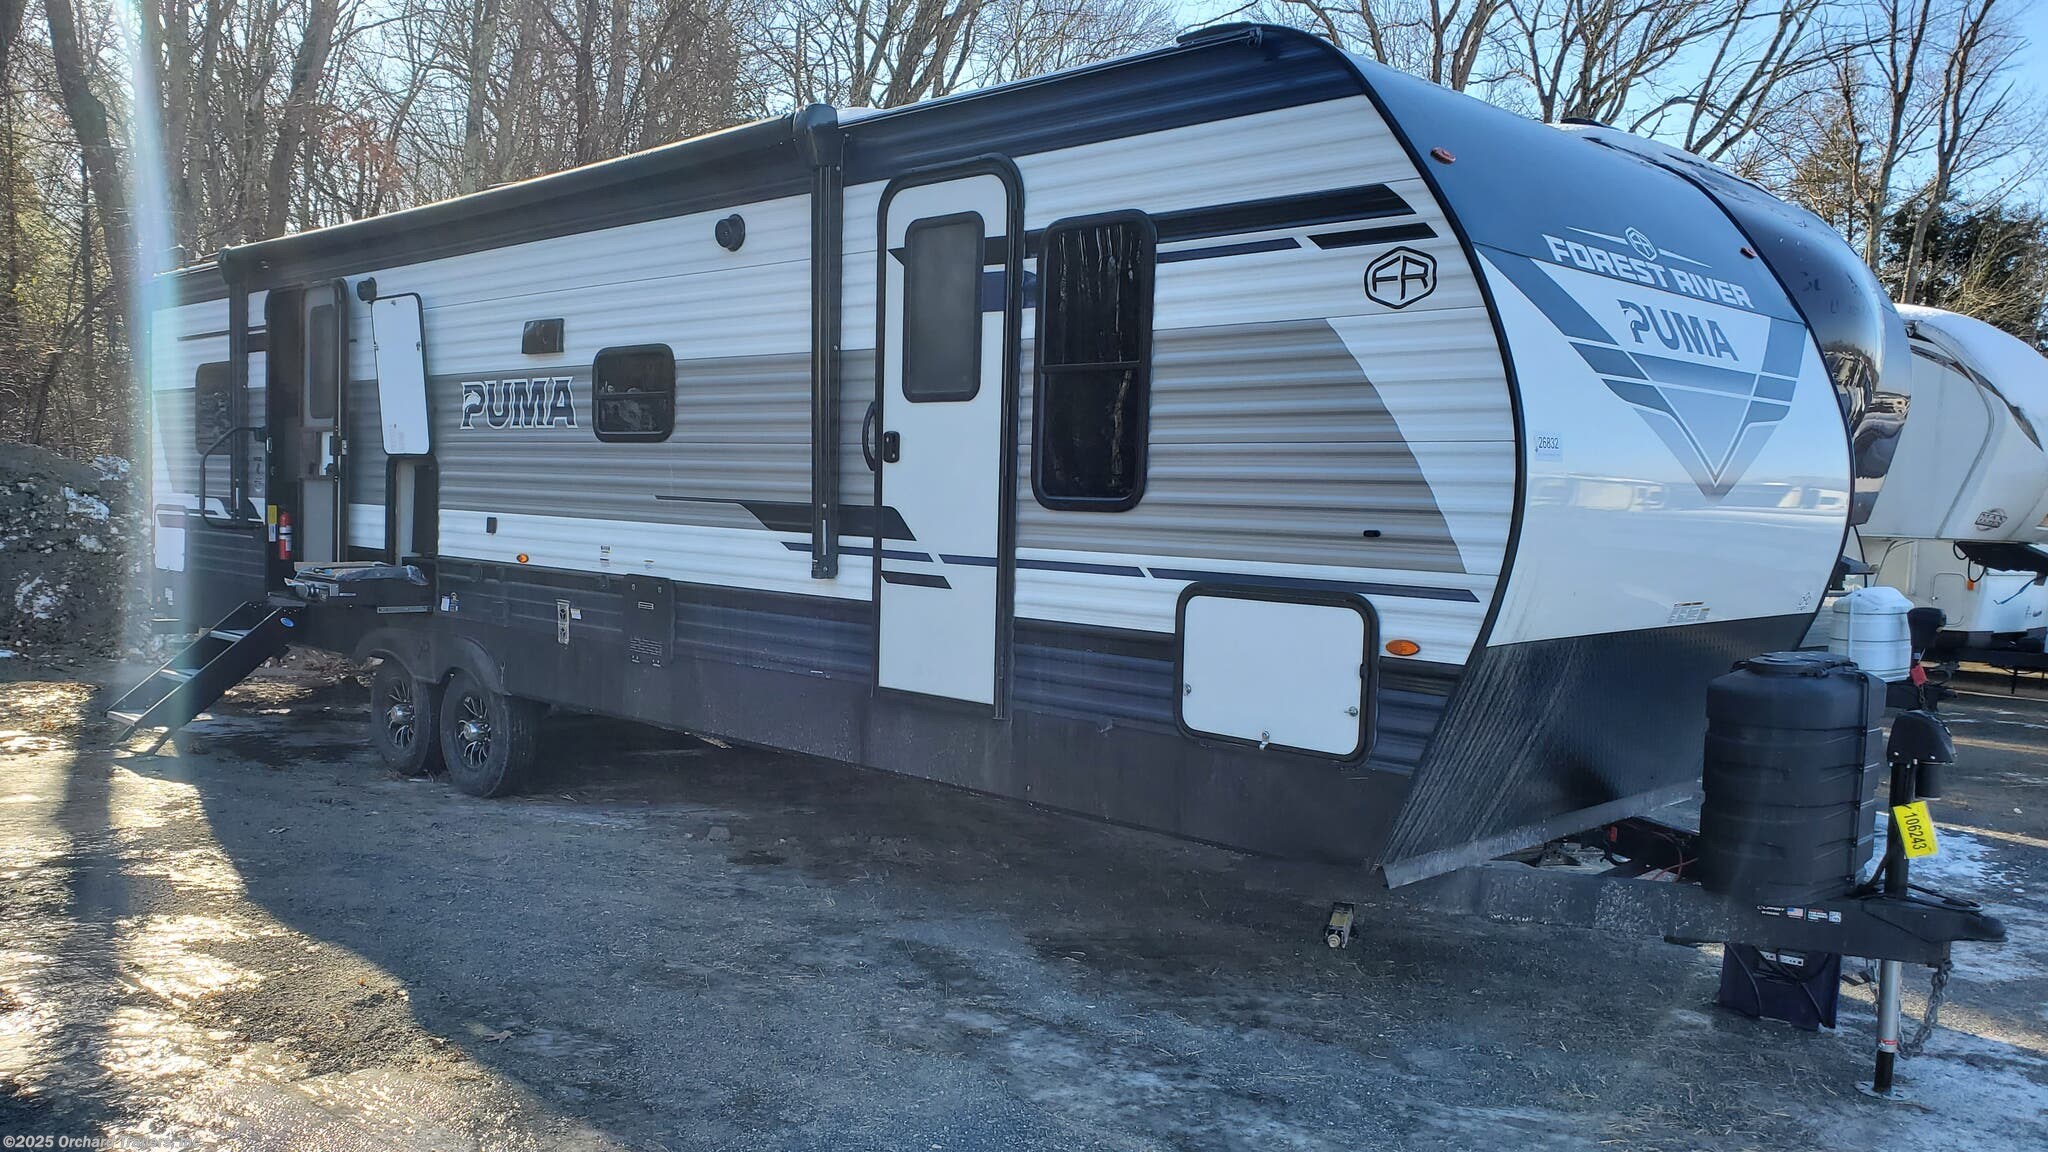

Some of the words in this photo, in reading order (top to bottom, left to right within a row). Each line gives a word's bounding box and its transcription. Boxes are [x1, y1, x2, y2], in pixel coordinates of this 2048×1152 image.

[1541, 233, 1669, 288] FOREST
[1669, 267, 1755, 309] RIVER
[1617, 298, 1740, 362] PUMA
[459, 376, 579, 430] PUMA
[1538, 436, 1559, 449] 26832
[1903, 812, 1927, 850] 106243
